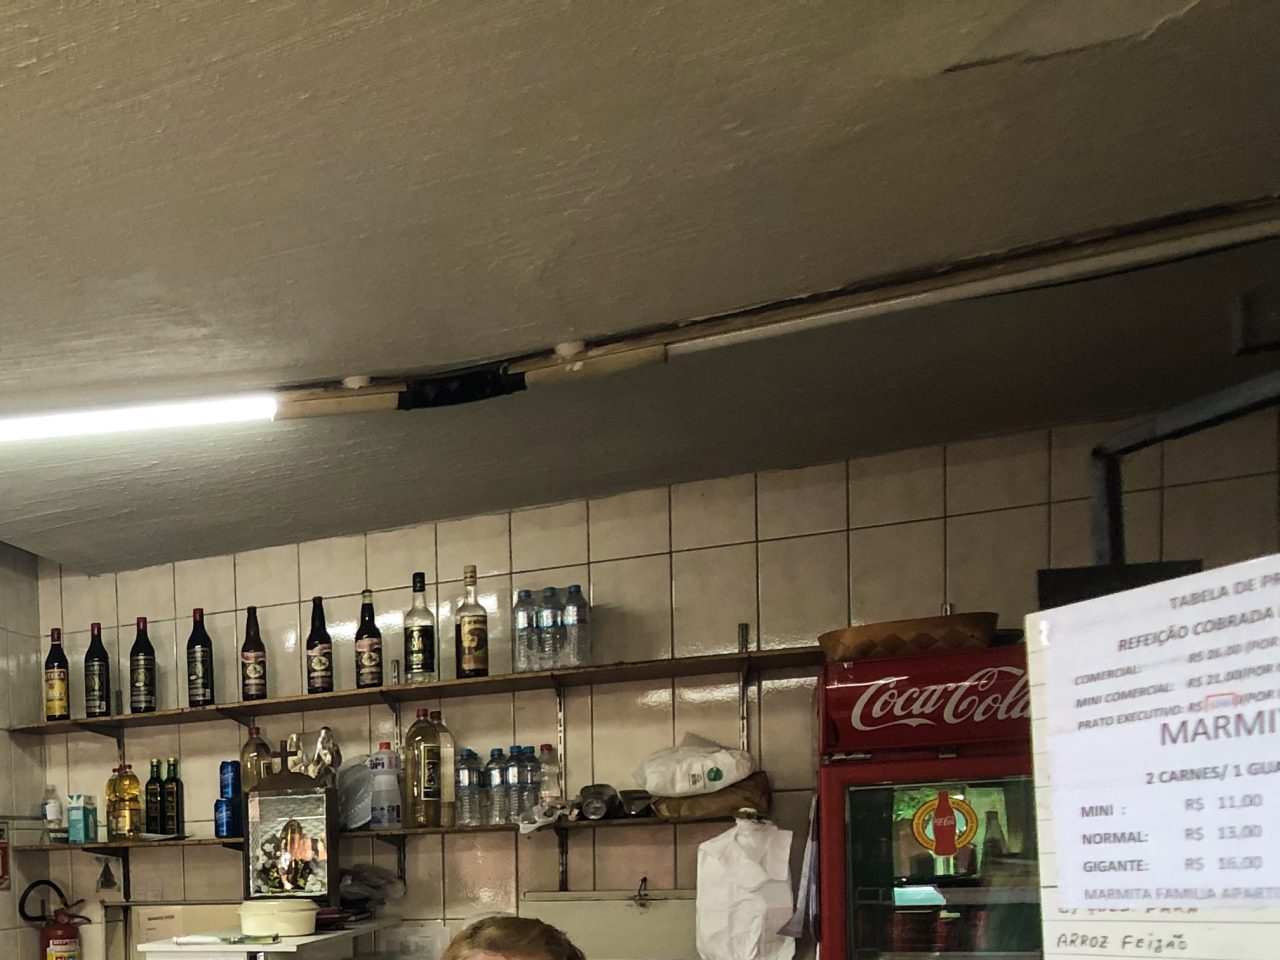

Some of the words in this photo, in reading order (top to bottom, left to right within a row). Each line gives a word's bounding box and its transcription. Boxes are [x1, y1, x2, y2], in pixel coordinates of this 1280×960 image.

[1170, 586, 1228, 609] TABELA
[1234, 577, 1257, 594] DE
[1118, 624, 1188, 652] REFEIÇÃO
[1192, 607, 1274, 635] COBRADA
[1076, 695, 1102, 708] MINI
[1078, 715, 1114, 730] PRATO
[1160, 709, 1280, 746] MARMI
[1146, 772, 1154, 785] 2
[1234, 765, 1242, 777] 1
[1081, 805, 1114, 818] MINI
[1082, 832, 1148, 845] NORMAL:
[1056, 932, 1109, 949] ARROZ
